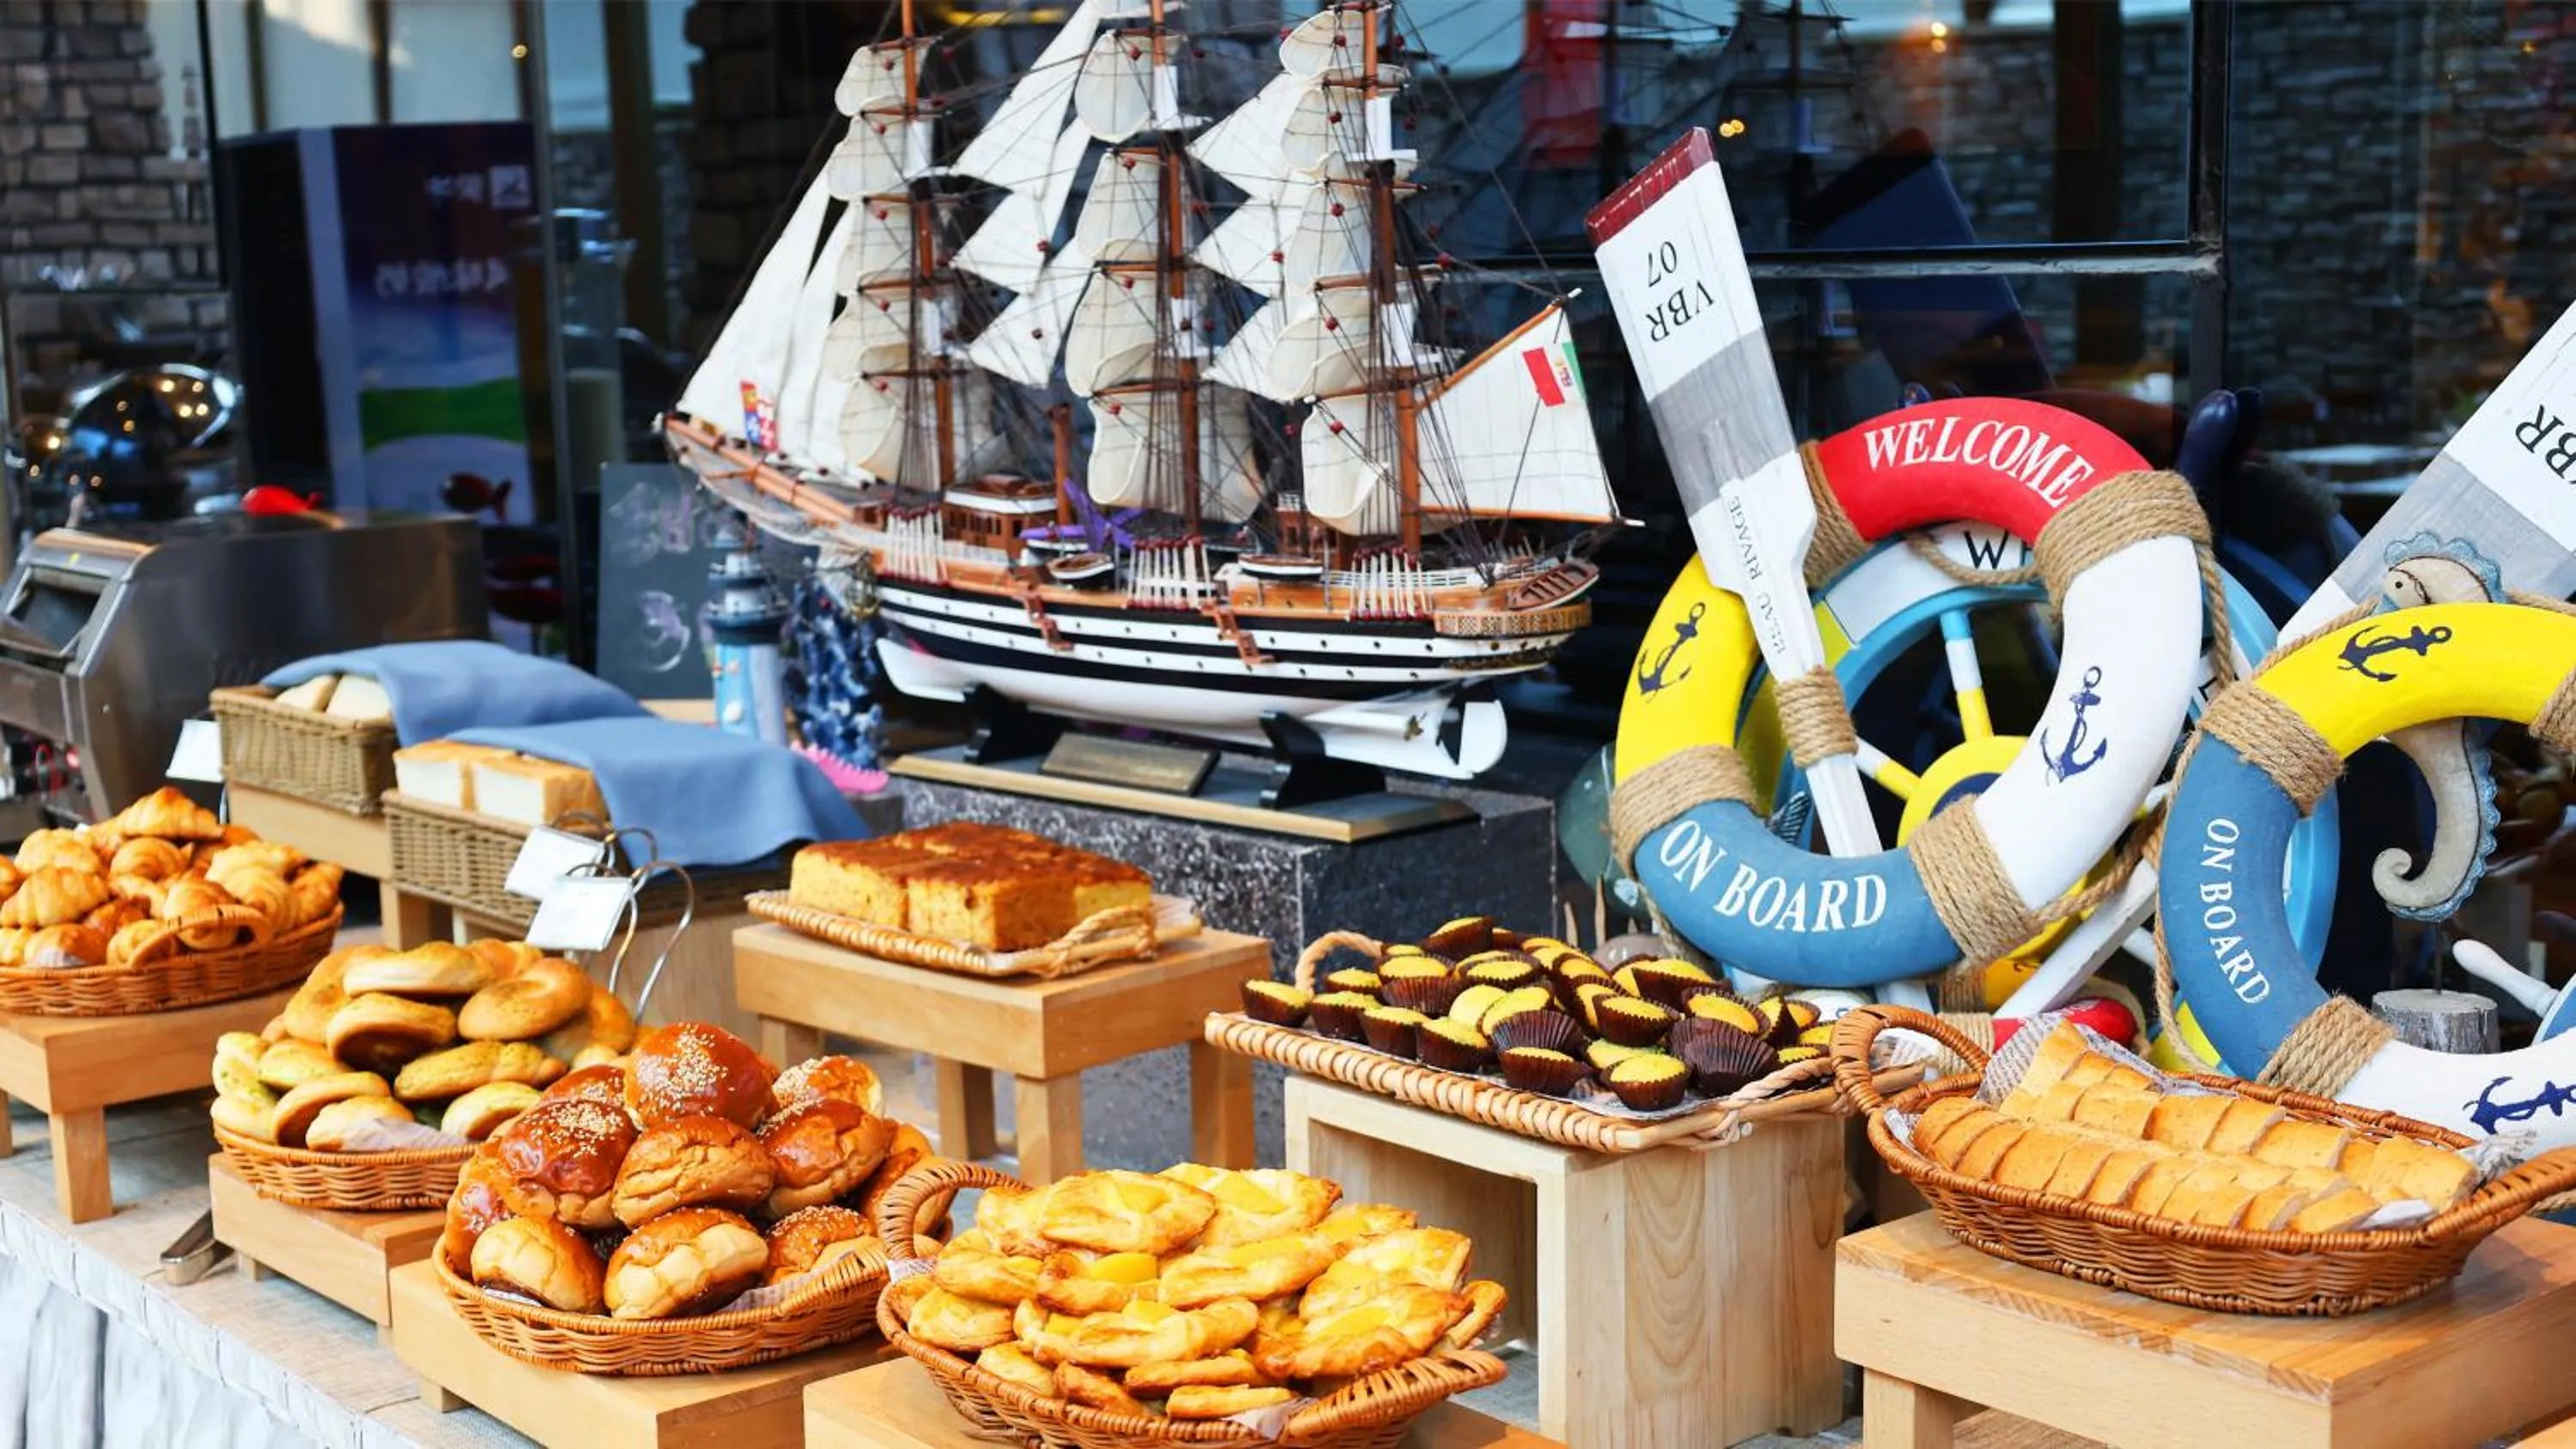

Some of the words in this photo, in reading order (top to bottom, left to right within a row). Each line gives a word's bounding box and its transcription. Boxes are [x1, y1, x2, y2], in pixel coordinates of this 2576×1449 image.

[1648, 241, 1677, 288] 07
[1646, 280, 1715, 342] VBR
[1863, 416, 2095, 508] WELCOME
[2515, 403, 2576, 485] BR
[1659, 820, 1728, 894] ON
[1713, 863, 1887, 933] BOARD
[2202, 817, 2240, 873] ON
[2199, 882, 2271, 1005] BOARD
